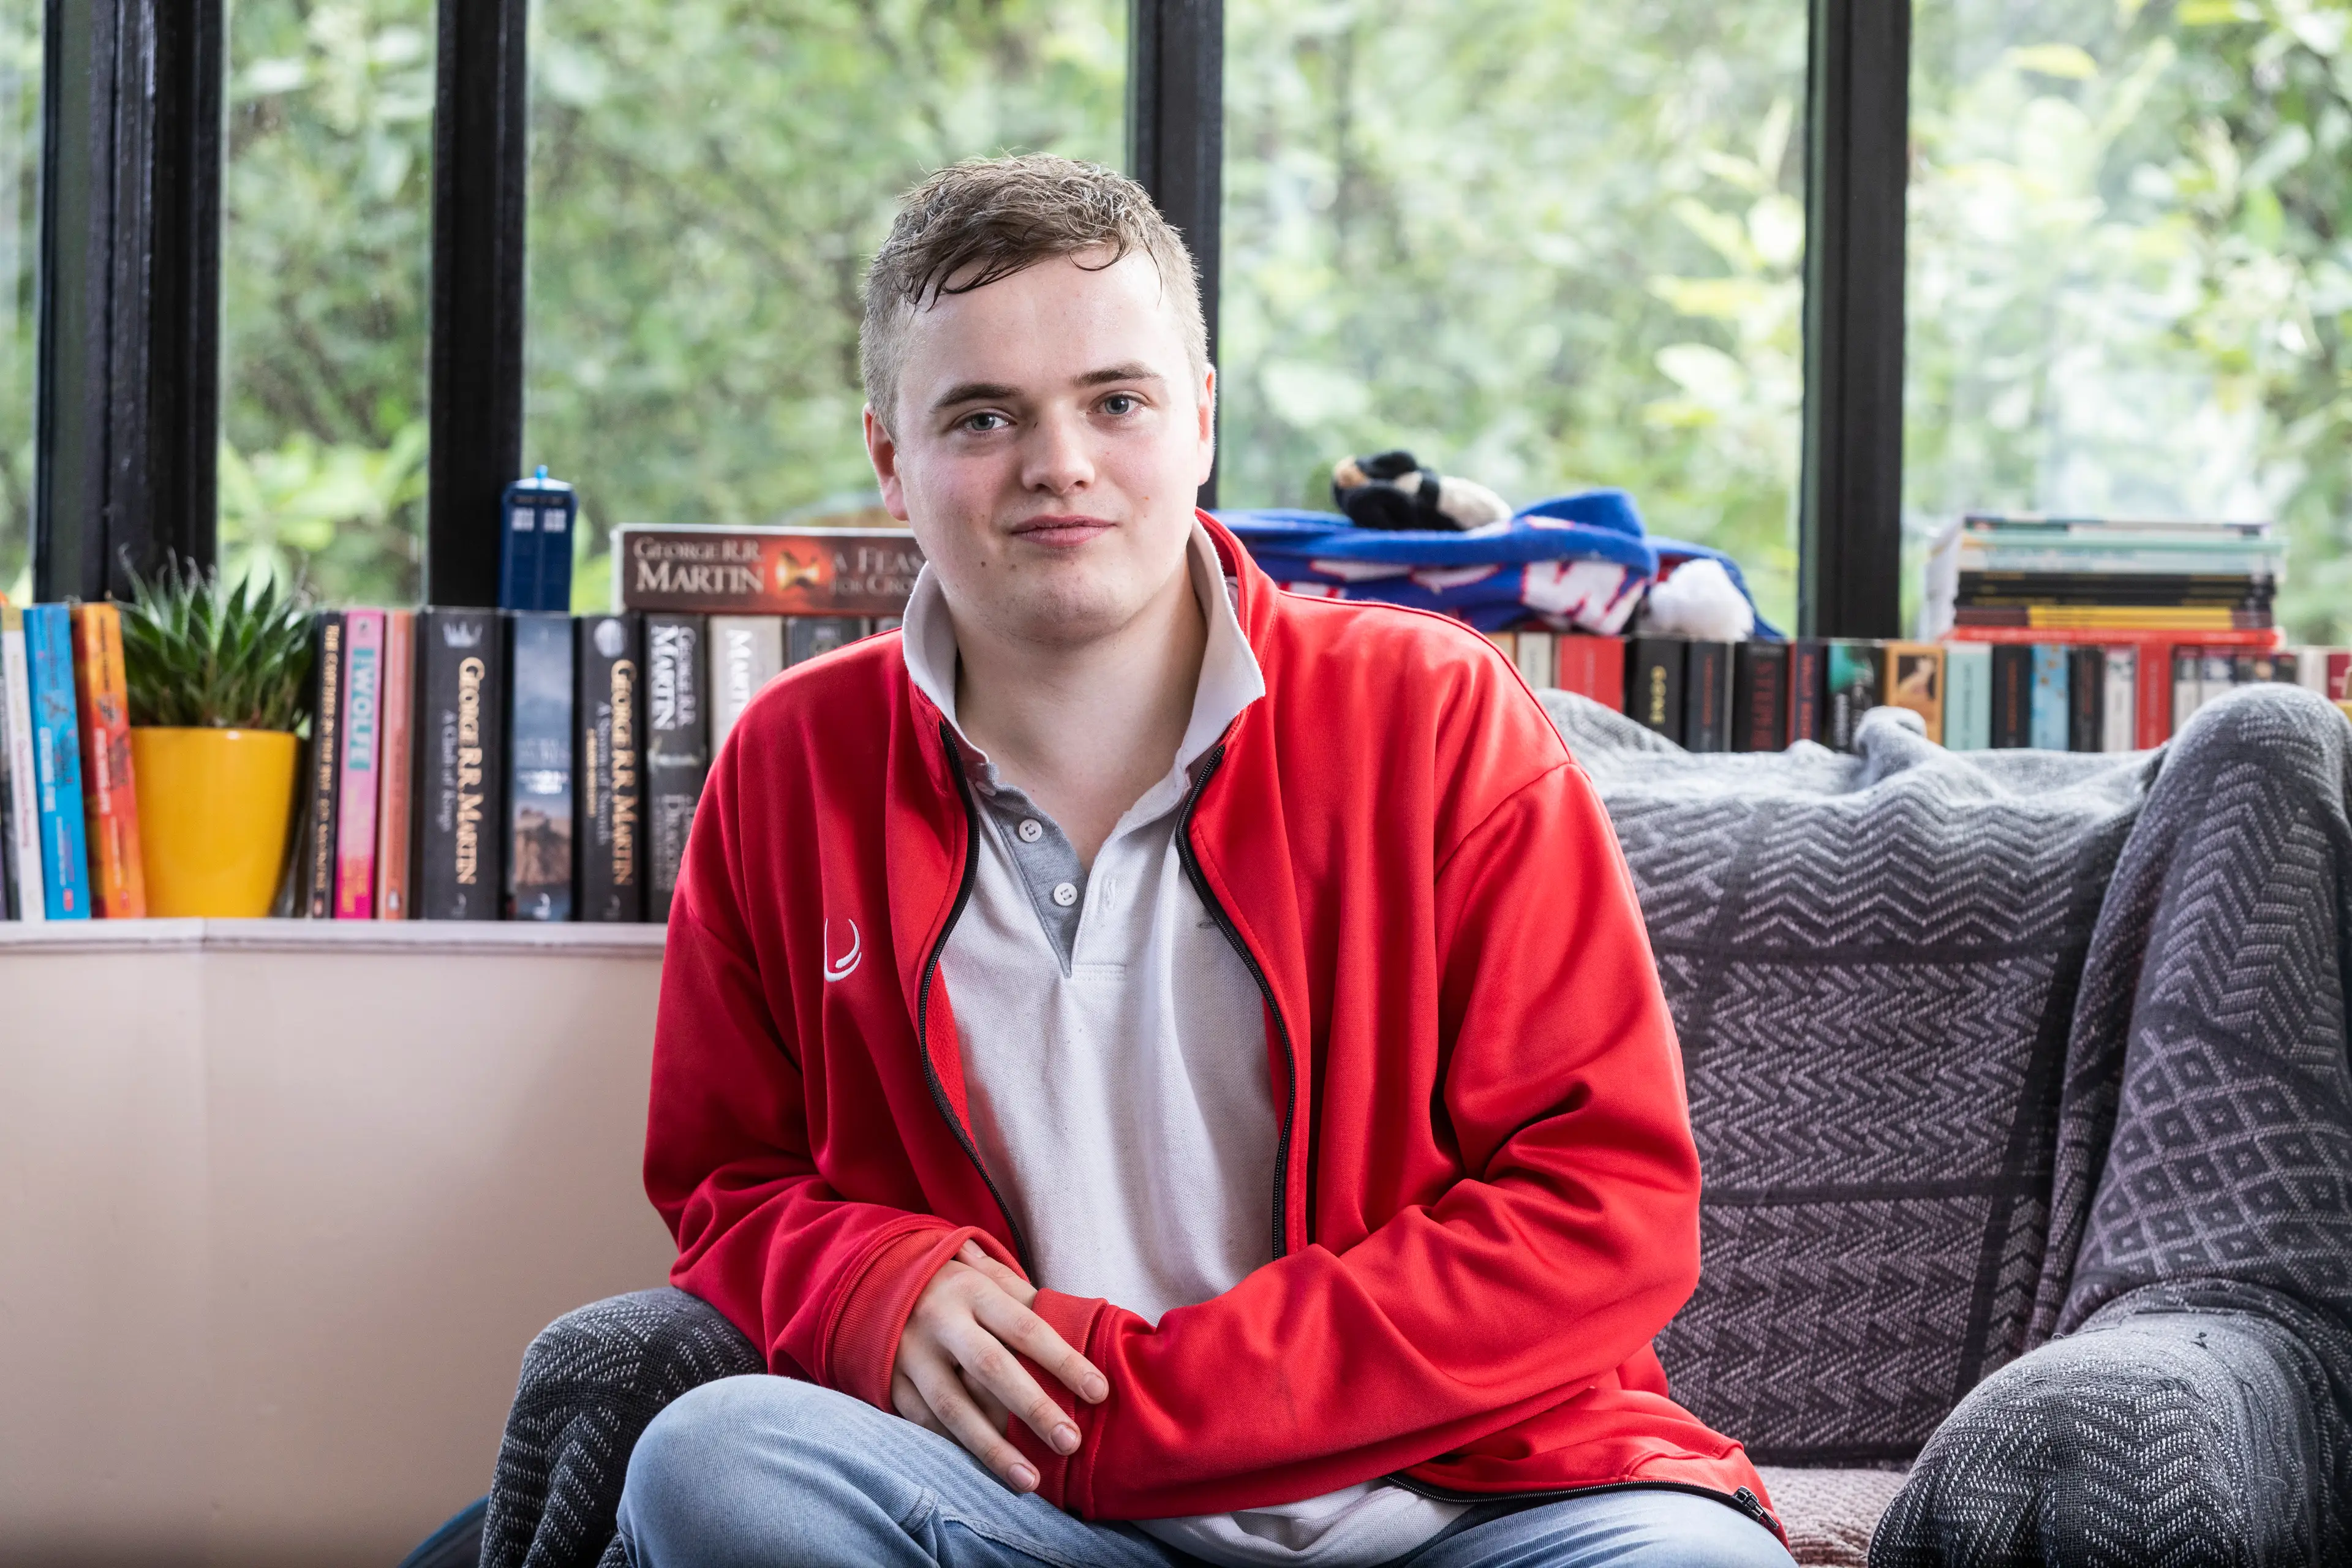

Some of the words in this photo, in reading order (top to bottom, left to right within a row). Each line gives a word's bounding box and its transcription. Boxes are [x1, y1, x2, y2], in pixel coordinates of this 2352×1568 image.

[633, 535, 721, 562] GEORGE
[636, 559, 765, 594] MARTIN
[856, 546, 925, 575] FEAS
[866, 575, 917, 596] CRO
[351, 666, 375, 762] WOLFE
[458, 657, 485, 748] GEORGE
[611, 659, 638, 748] GEORGE
[650, 624, 679, 731] MARTIN
[726, 629, 753, 718] MARTI
[1649, 665, 1667, 725] GONE
[456, 792, 483, 884] MARTIN
[612, 794, 639, 885] MARTIN
